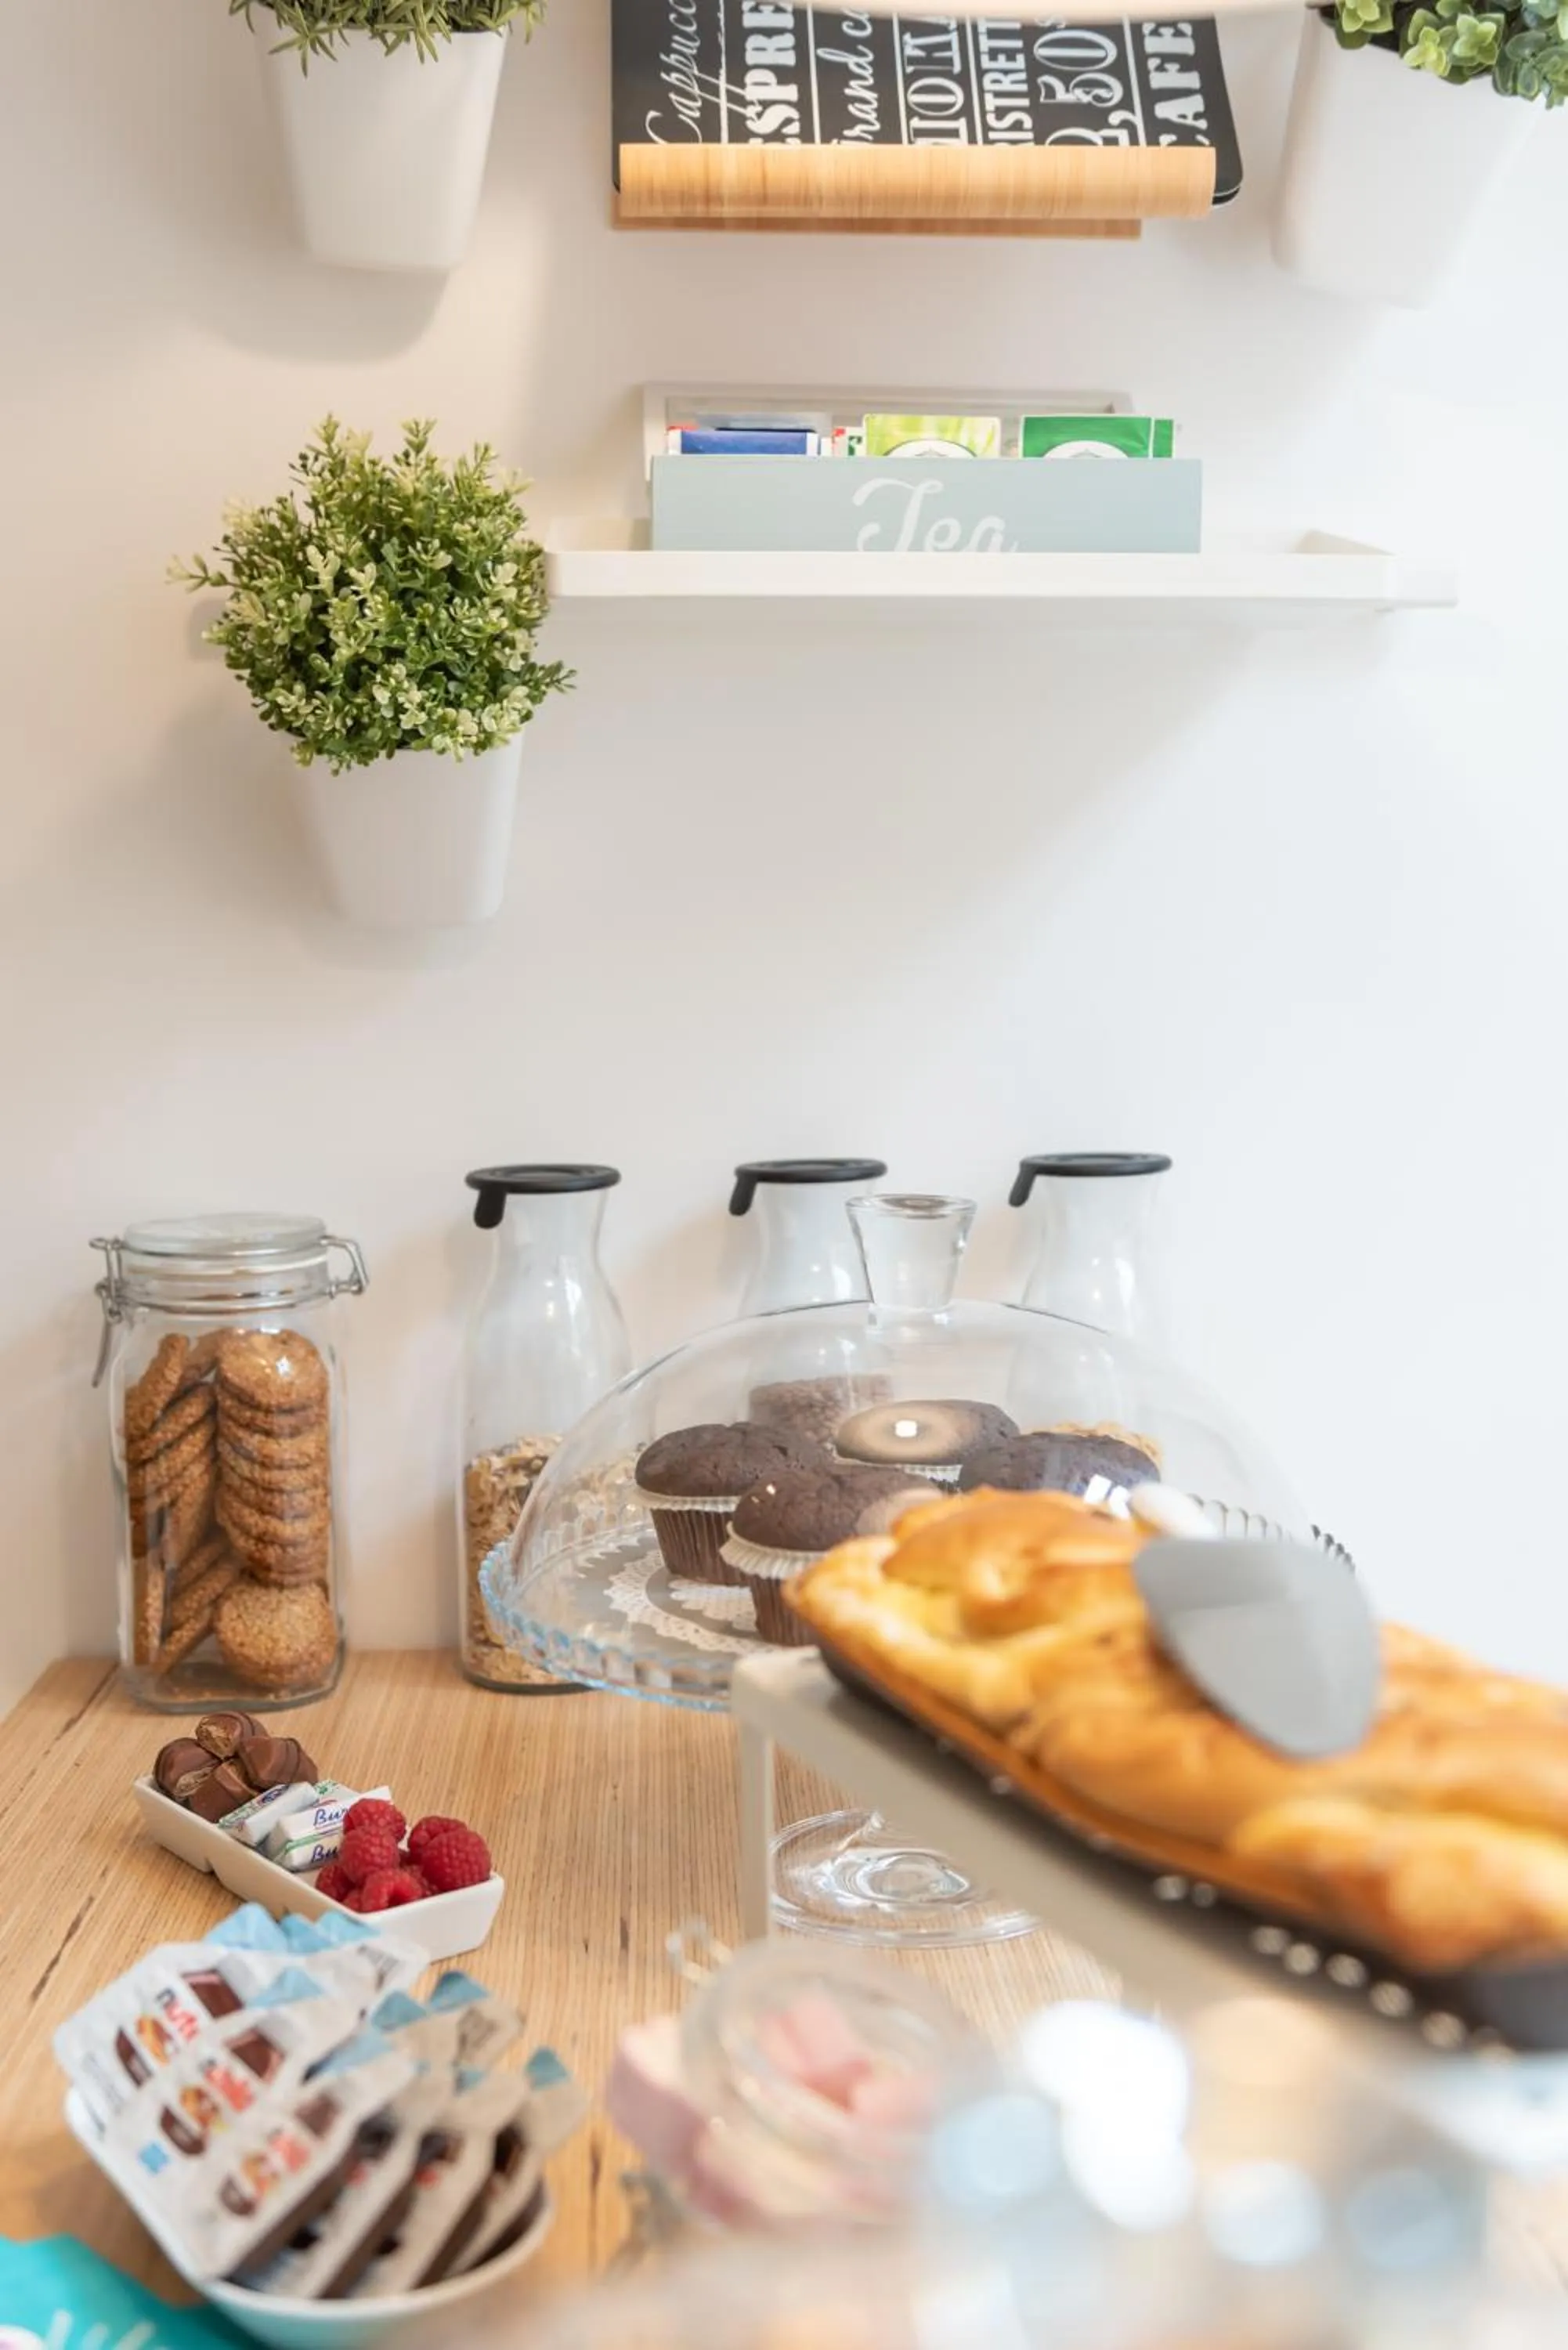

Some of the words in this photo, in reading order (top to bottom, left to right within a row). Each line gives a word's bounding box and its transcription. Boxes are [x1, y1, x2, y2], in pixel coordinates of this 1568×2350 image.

[742, 0, 801, 145] SPRE
[816, 44, 881, 145] rand
[976, 16, 1035, 146] ISTRETT
[851, 476, 1020, 552] Tea
